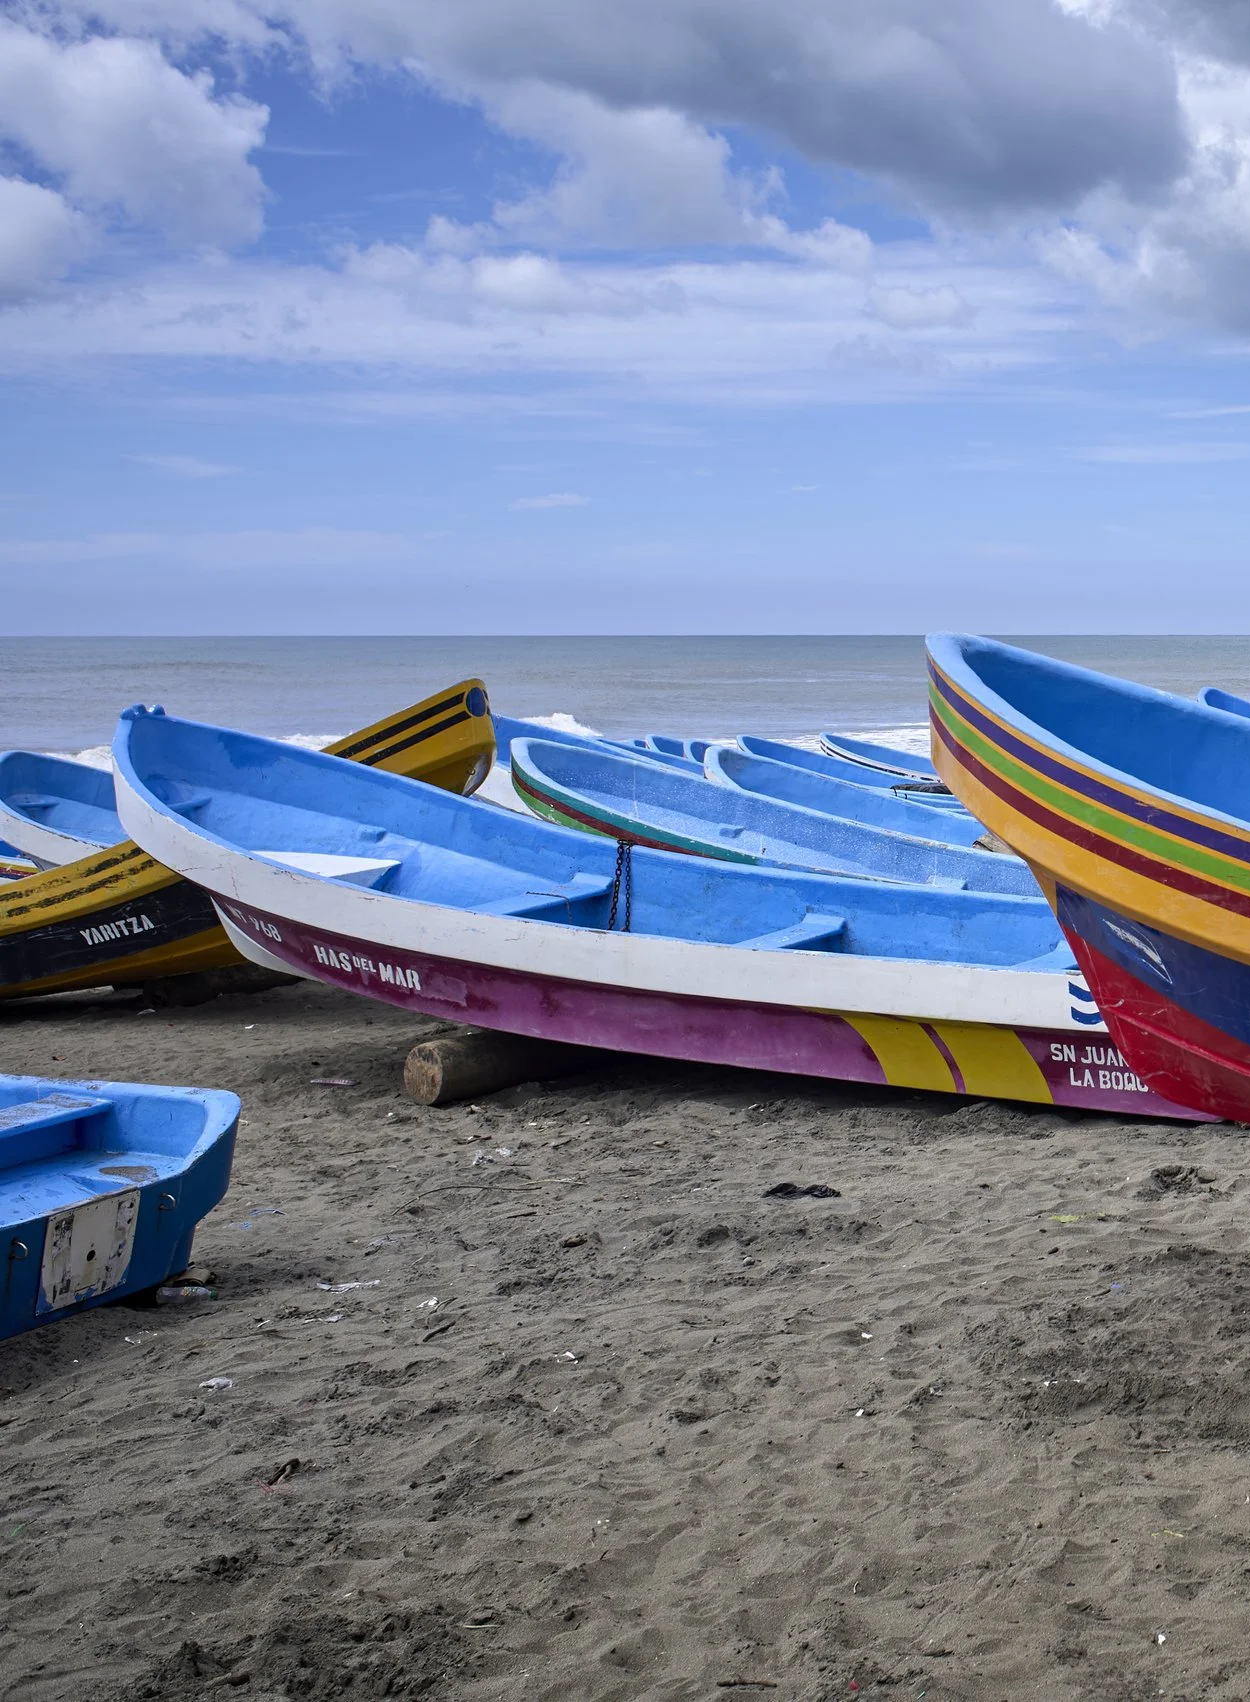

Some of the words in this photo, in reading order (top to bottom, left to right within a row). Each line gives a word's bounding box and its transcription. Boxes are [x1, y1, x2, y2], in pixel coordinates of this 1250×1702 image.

[80, 914, 155, 946] YARITZA
[313, 944, 352, 972] HAS
[352, 957, 377, 973] DEL
[378, 962, 421, 991] MAR
[1050, 1043, 1077, 1063] SN
[1069, 1067, 1095, 1088] LA
[1099, 1070, 1156, 1094] BOQU
